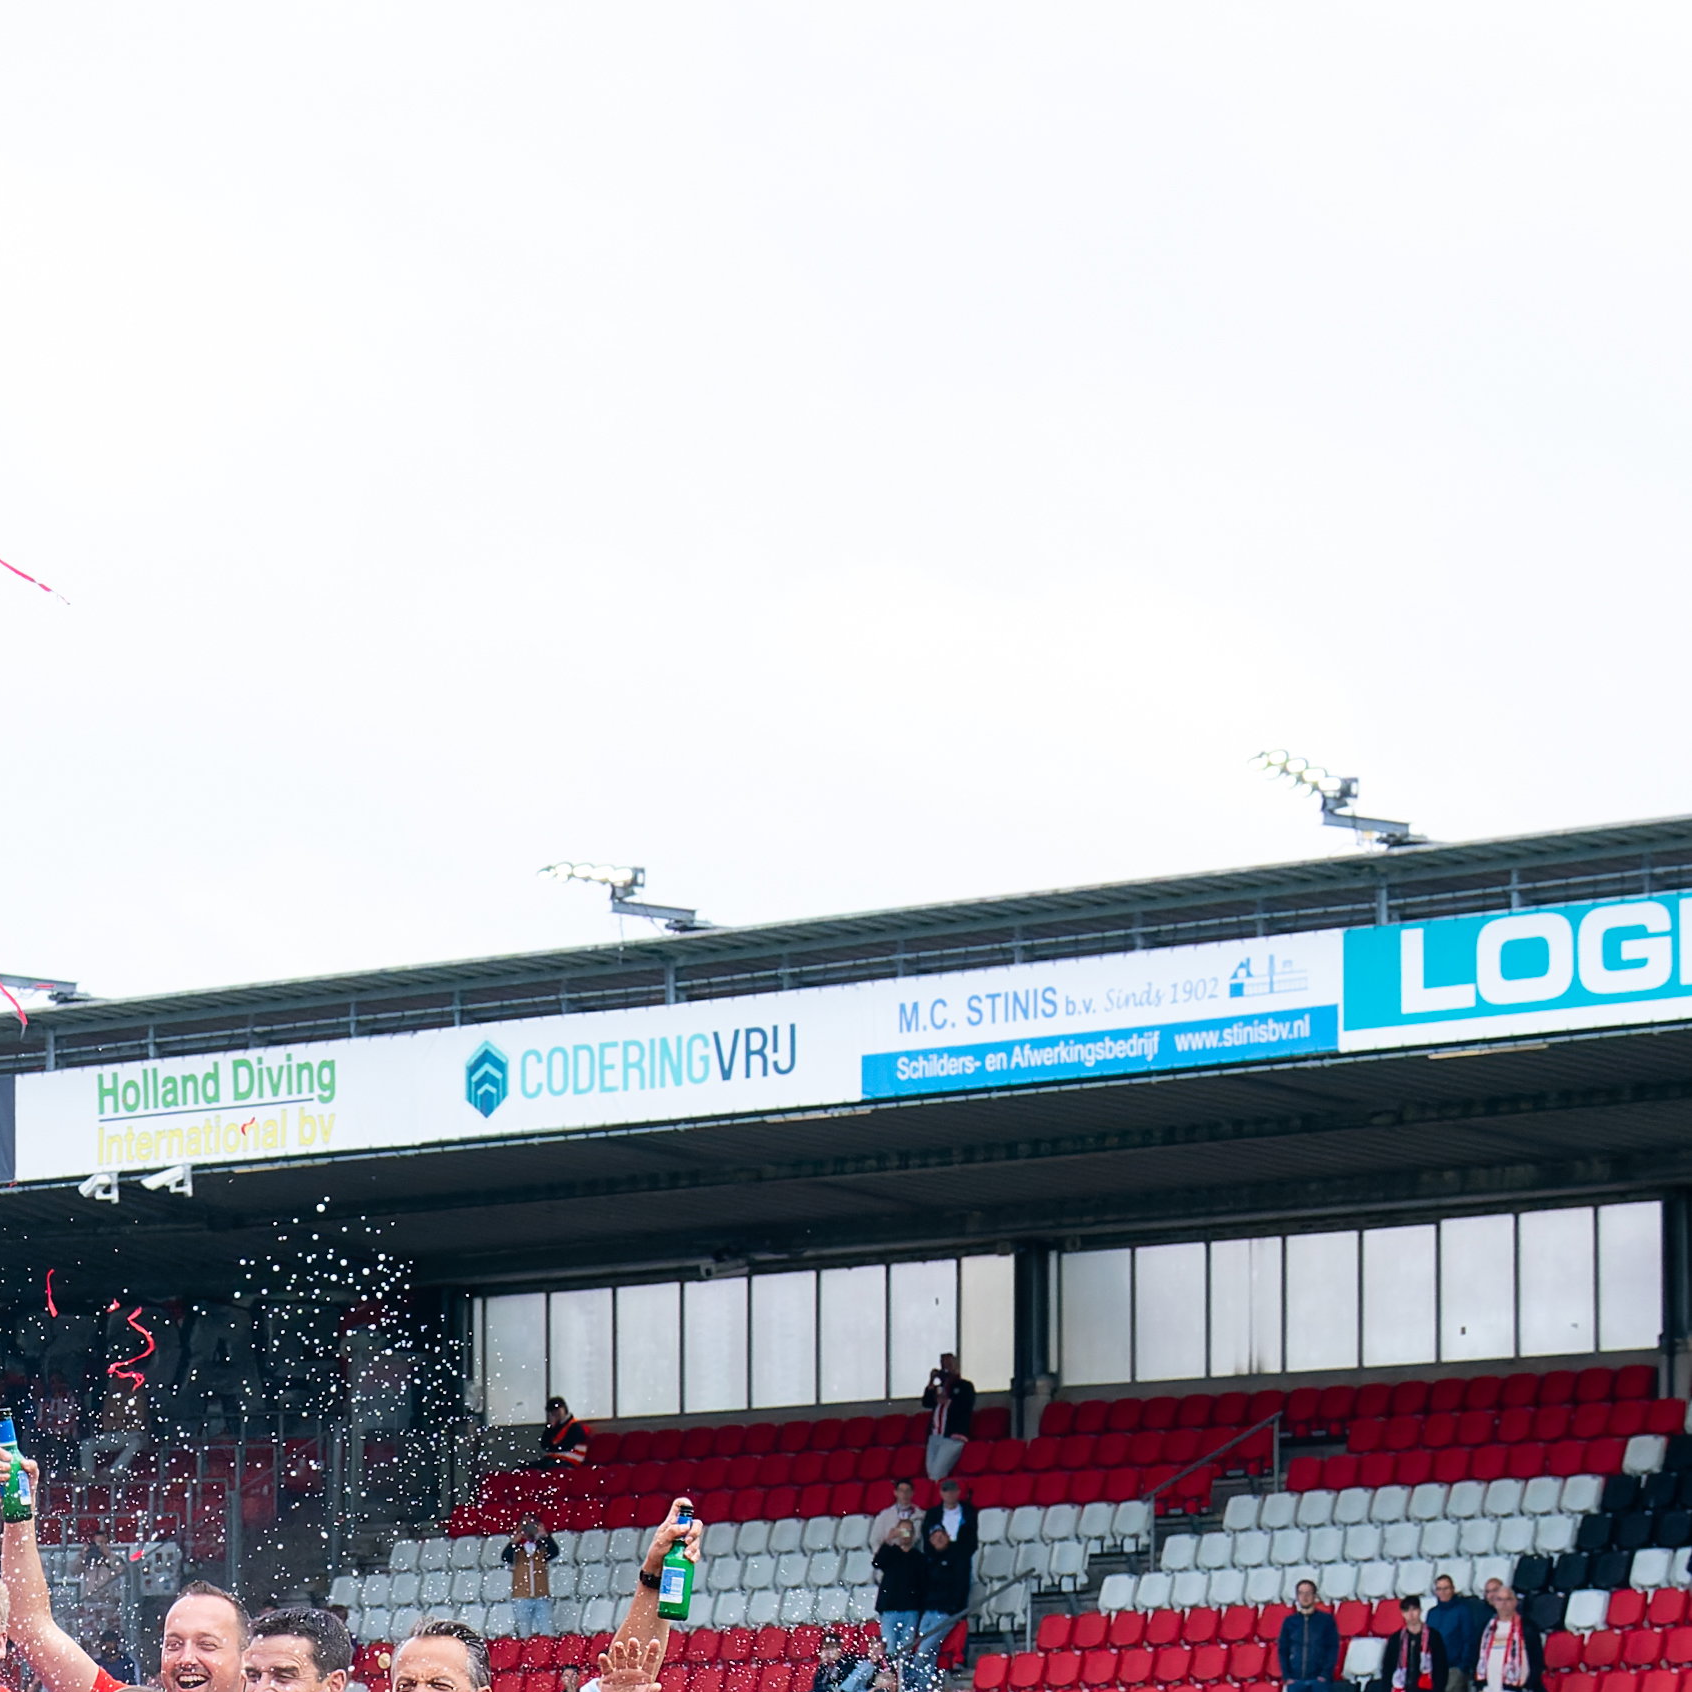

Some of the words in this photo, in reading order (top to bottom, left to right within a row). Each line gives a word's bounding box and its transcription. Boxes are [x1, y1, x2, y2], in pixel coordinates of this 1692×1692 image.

[1401, 898, 1692, 1014] LOGI
[899, 999, 956, 1033] M.C.
[967, 987, 1058, 1025] STINIS
[1065, 994, 1096, 1017] b.v.
[1104, 982, 1164, 1013] Sinds
[1170, 977, 1220, 1005] 1902
[896, 1049, 982, 1081] Schilders-
[985, 1050, 1008, 1071] en
[1010, 1031, 1160, 1069] Afwerkingsbedrijf
[1174, 1013, 1311, 1053] www.stinisbv.nl
[97, 1061, 220, 1115] Holland
[232, 1053, 336, 1104] Diving
[97, 1109, 287, 1165] International
[298, 1107, 336, 1146] bv
